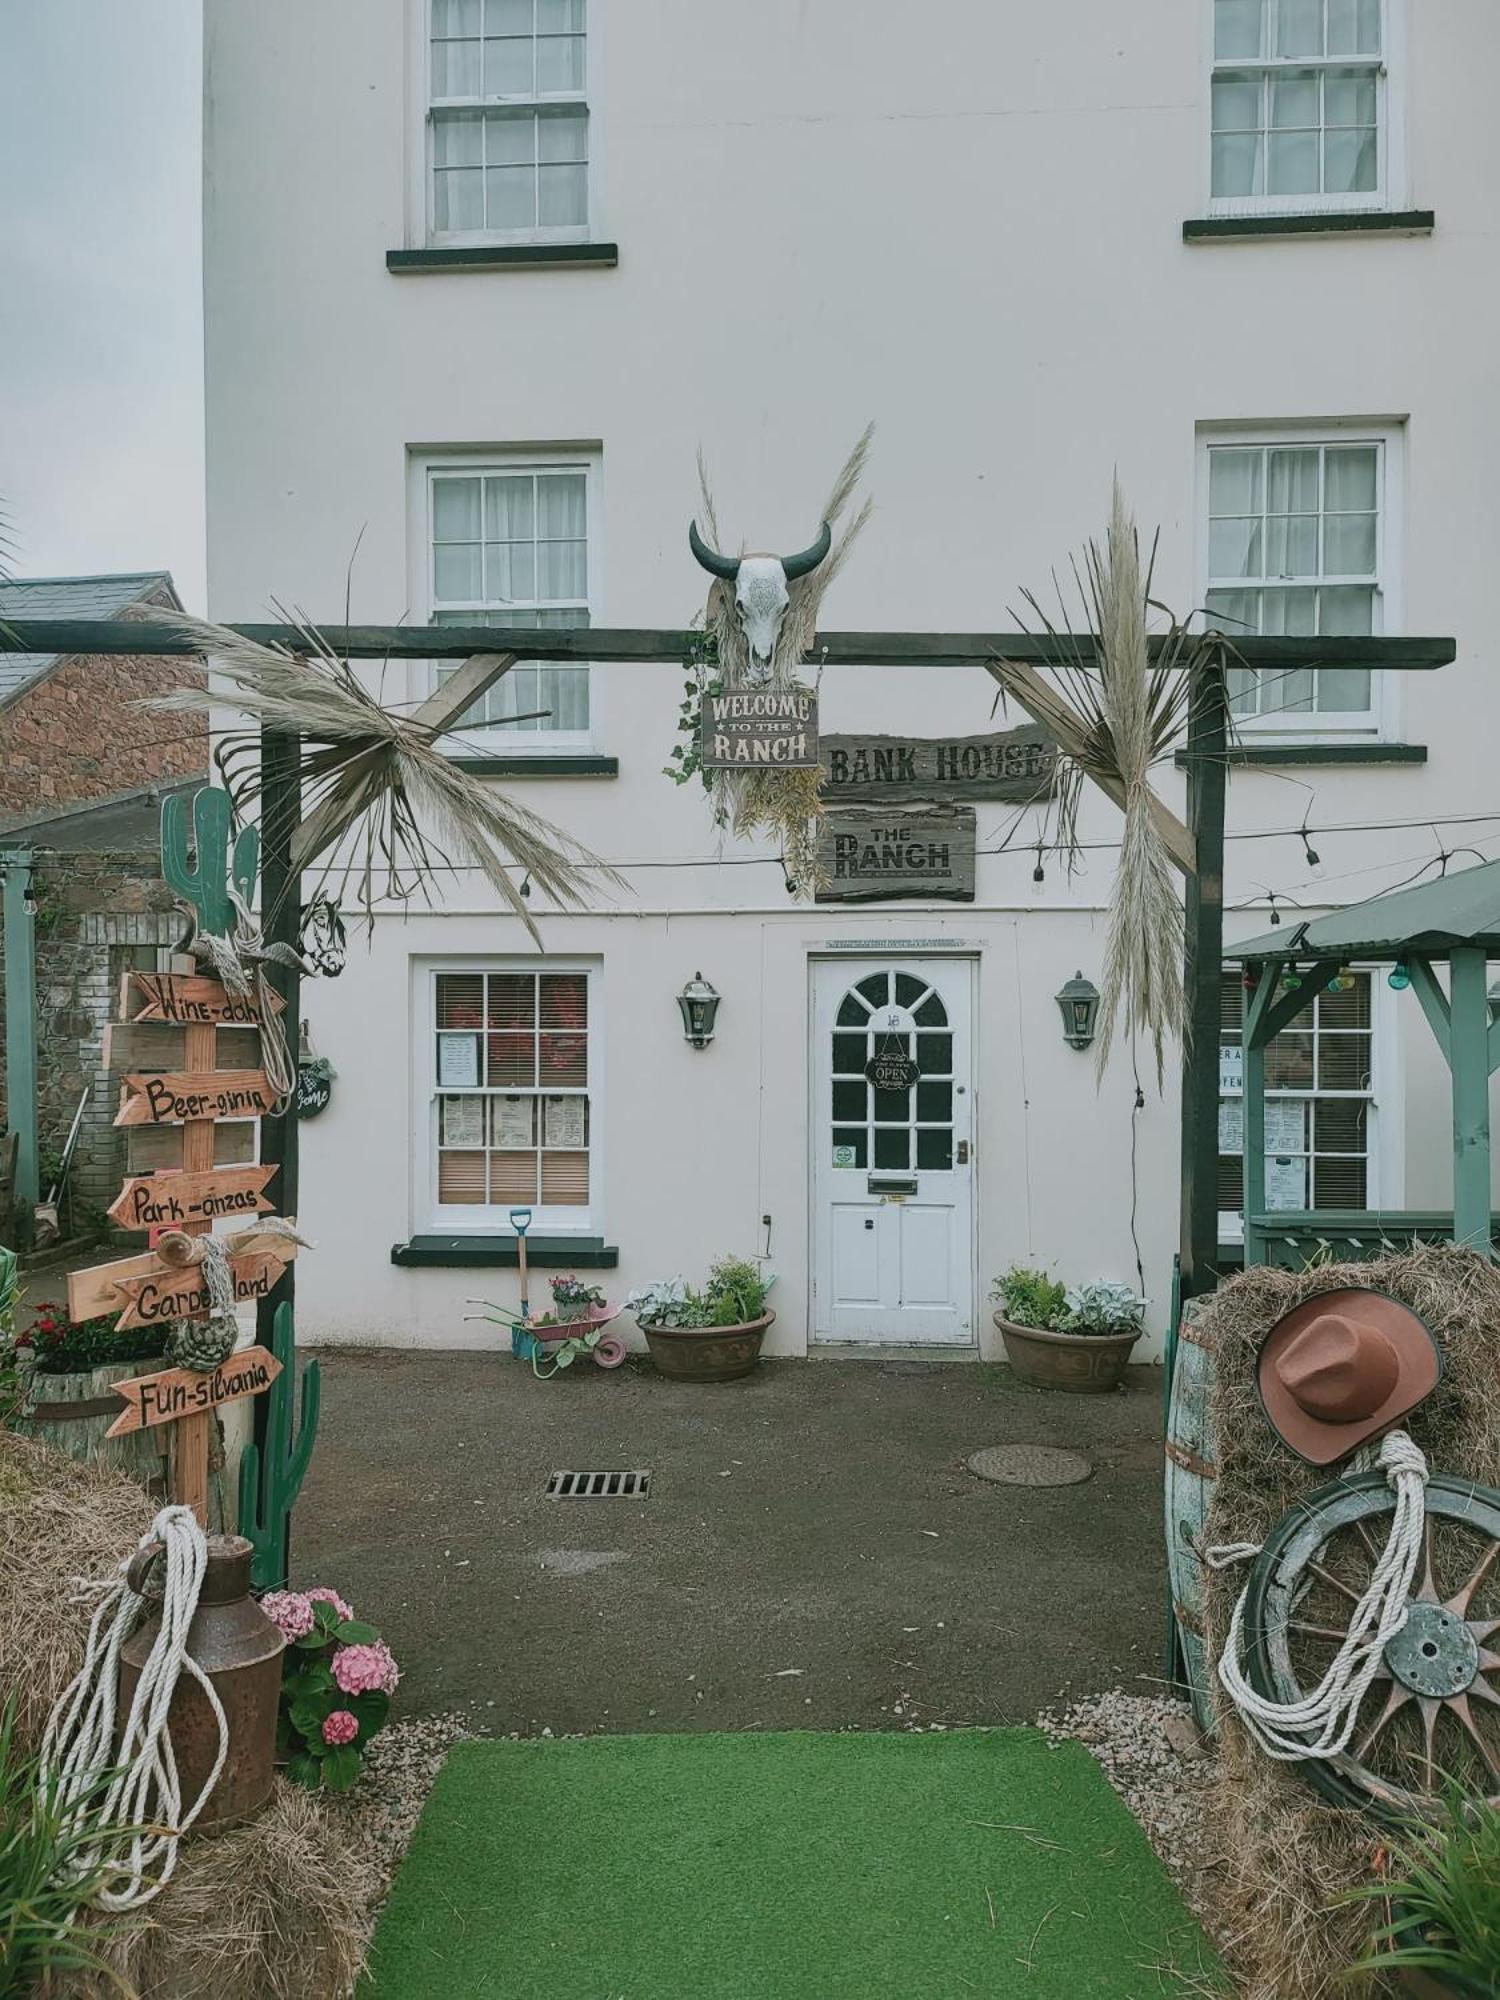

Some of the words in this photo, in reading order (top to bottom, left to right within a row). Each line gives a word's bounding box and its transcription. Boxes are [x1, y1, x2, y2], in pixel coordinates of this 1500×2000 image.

[711, 694, 809, 721] WELCOME
[728, 723, 752, 733] TO
[755, 723, 792, 733] THE
[713, 733, 807, 762] RANCH
[829, 748, 918, 784] BANK
[935, 743, 1044, 781] HOUSE
[870, 828, 911, 841] THE
[834, 834, 951, 878] RANCH
[875, 1067, 908, 1081] OPEN
